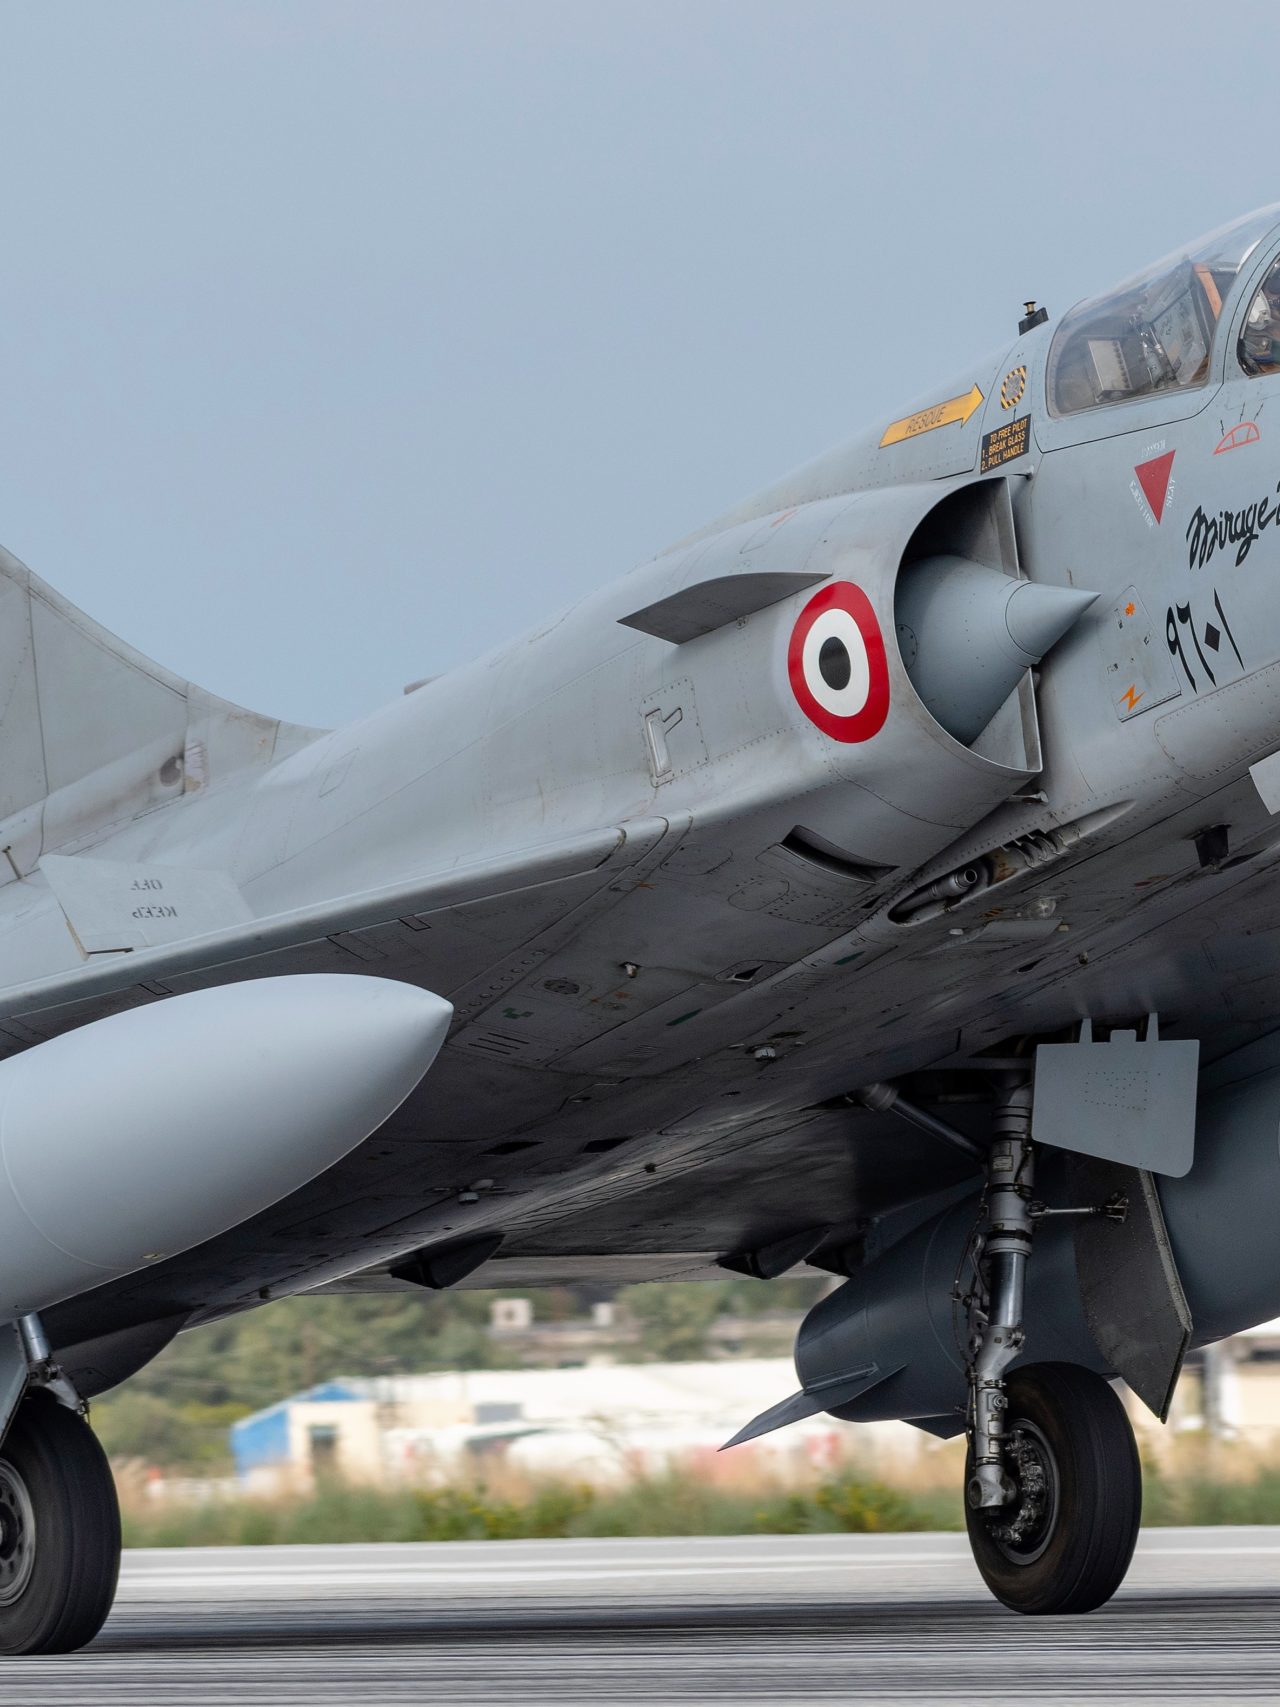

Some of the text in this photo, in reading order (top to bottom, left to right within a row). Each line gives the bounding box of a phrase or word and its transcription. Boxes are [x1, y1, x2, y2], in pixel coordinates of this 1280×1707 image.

[905, 406, 947, 434] RESCUE
[990, 418, 1028, 444] TO FREE PILOT
[989, 439, 1006, 456] BREAK
[1007, 430, 1025, 447] GLASS
[981, 442, 1025, 471] 2. PULL HANDLE
[130, 879, 163, 891] OFF
[132, 906, 178, 919] KEEP
